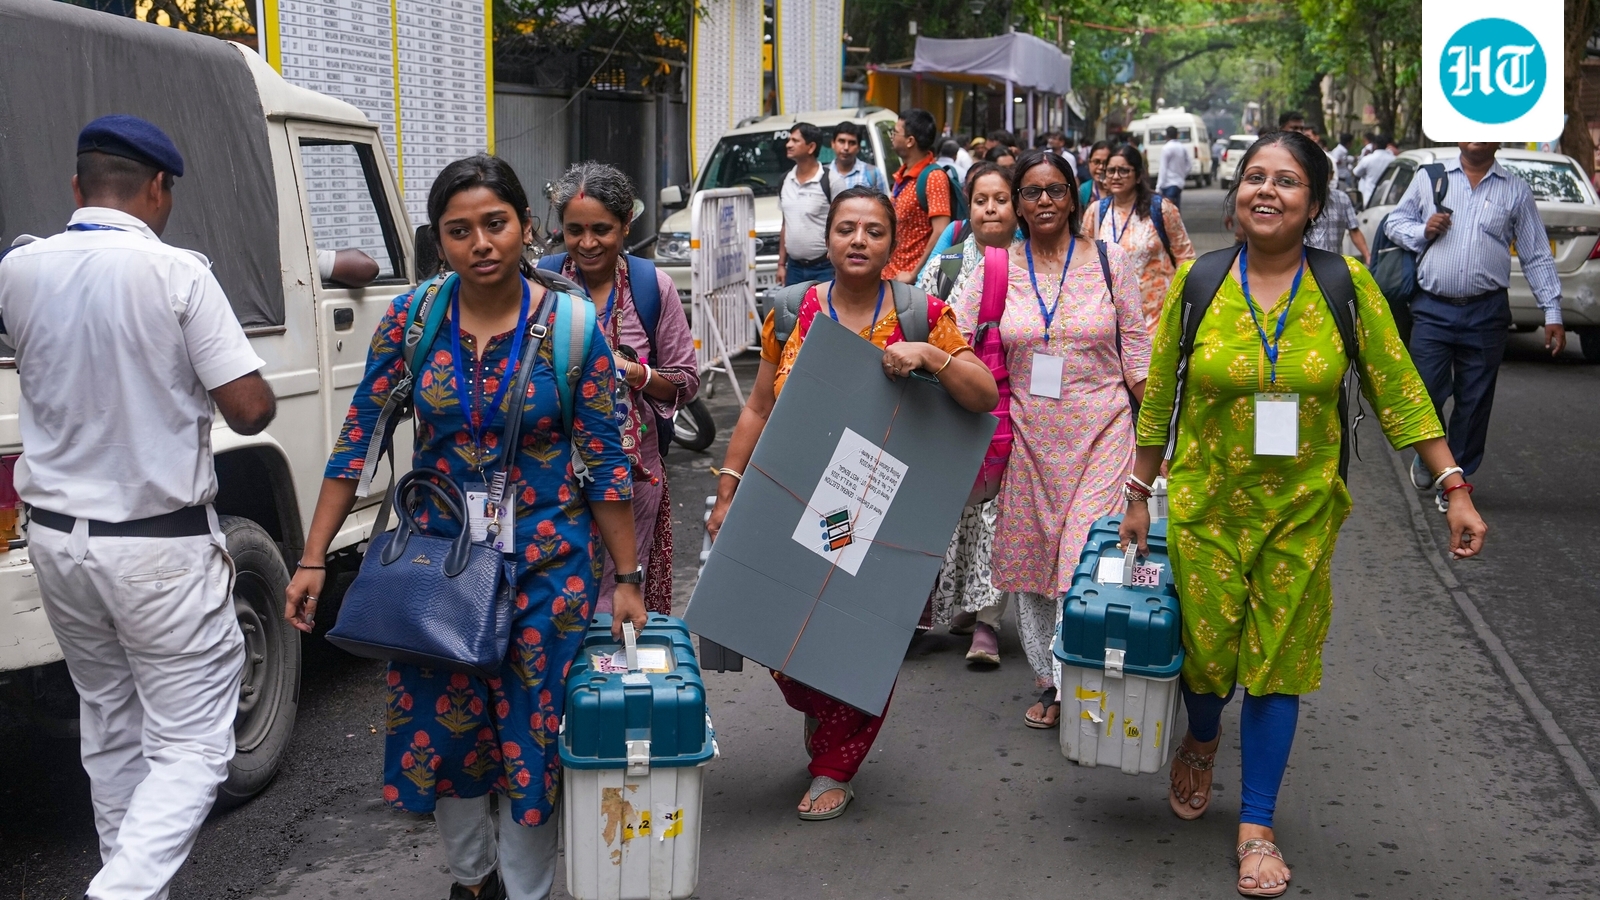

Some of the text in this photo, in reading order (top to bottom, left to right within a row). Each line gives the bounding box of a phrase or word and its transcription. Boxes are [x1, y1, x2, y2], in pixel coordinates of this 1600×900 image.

[773, 130, 792, 140] PO
[757, 274, 777, 284] N91
[824, 476, 841, 490] ELECTION
[840, 485, 854, 498] GENERAL
